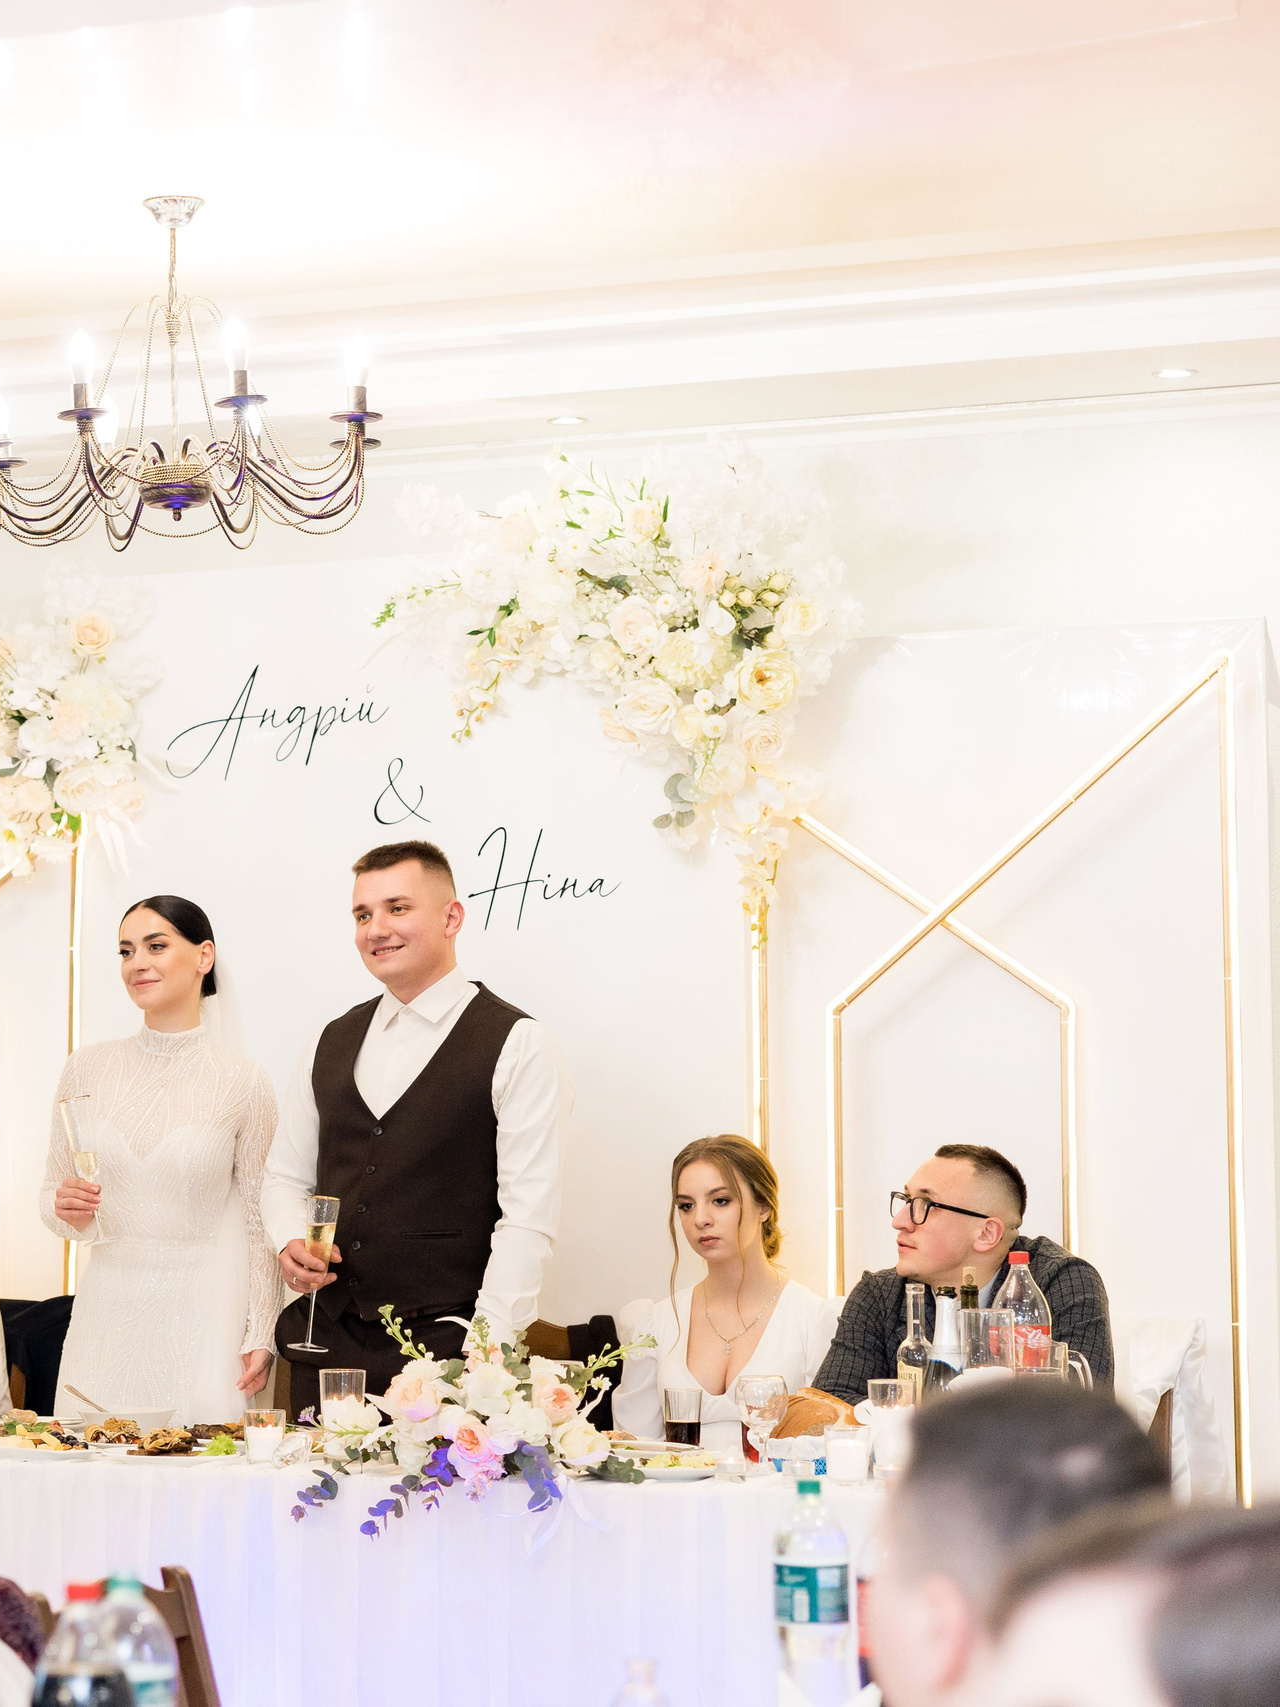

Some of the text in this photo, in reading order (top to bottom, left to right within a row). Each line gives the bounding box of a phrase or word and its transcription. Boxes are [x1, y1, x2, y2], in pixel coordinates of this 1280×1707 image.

[165, 663, 391, 781] Андрій
[373, 757, 432, 825] &
[467, 826, 621, 931] Ніна
